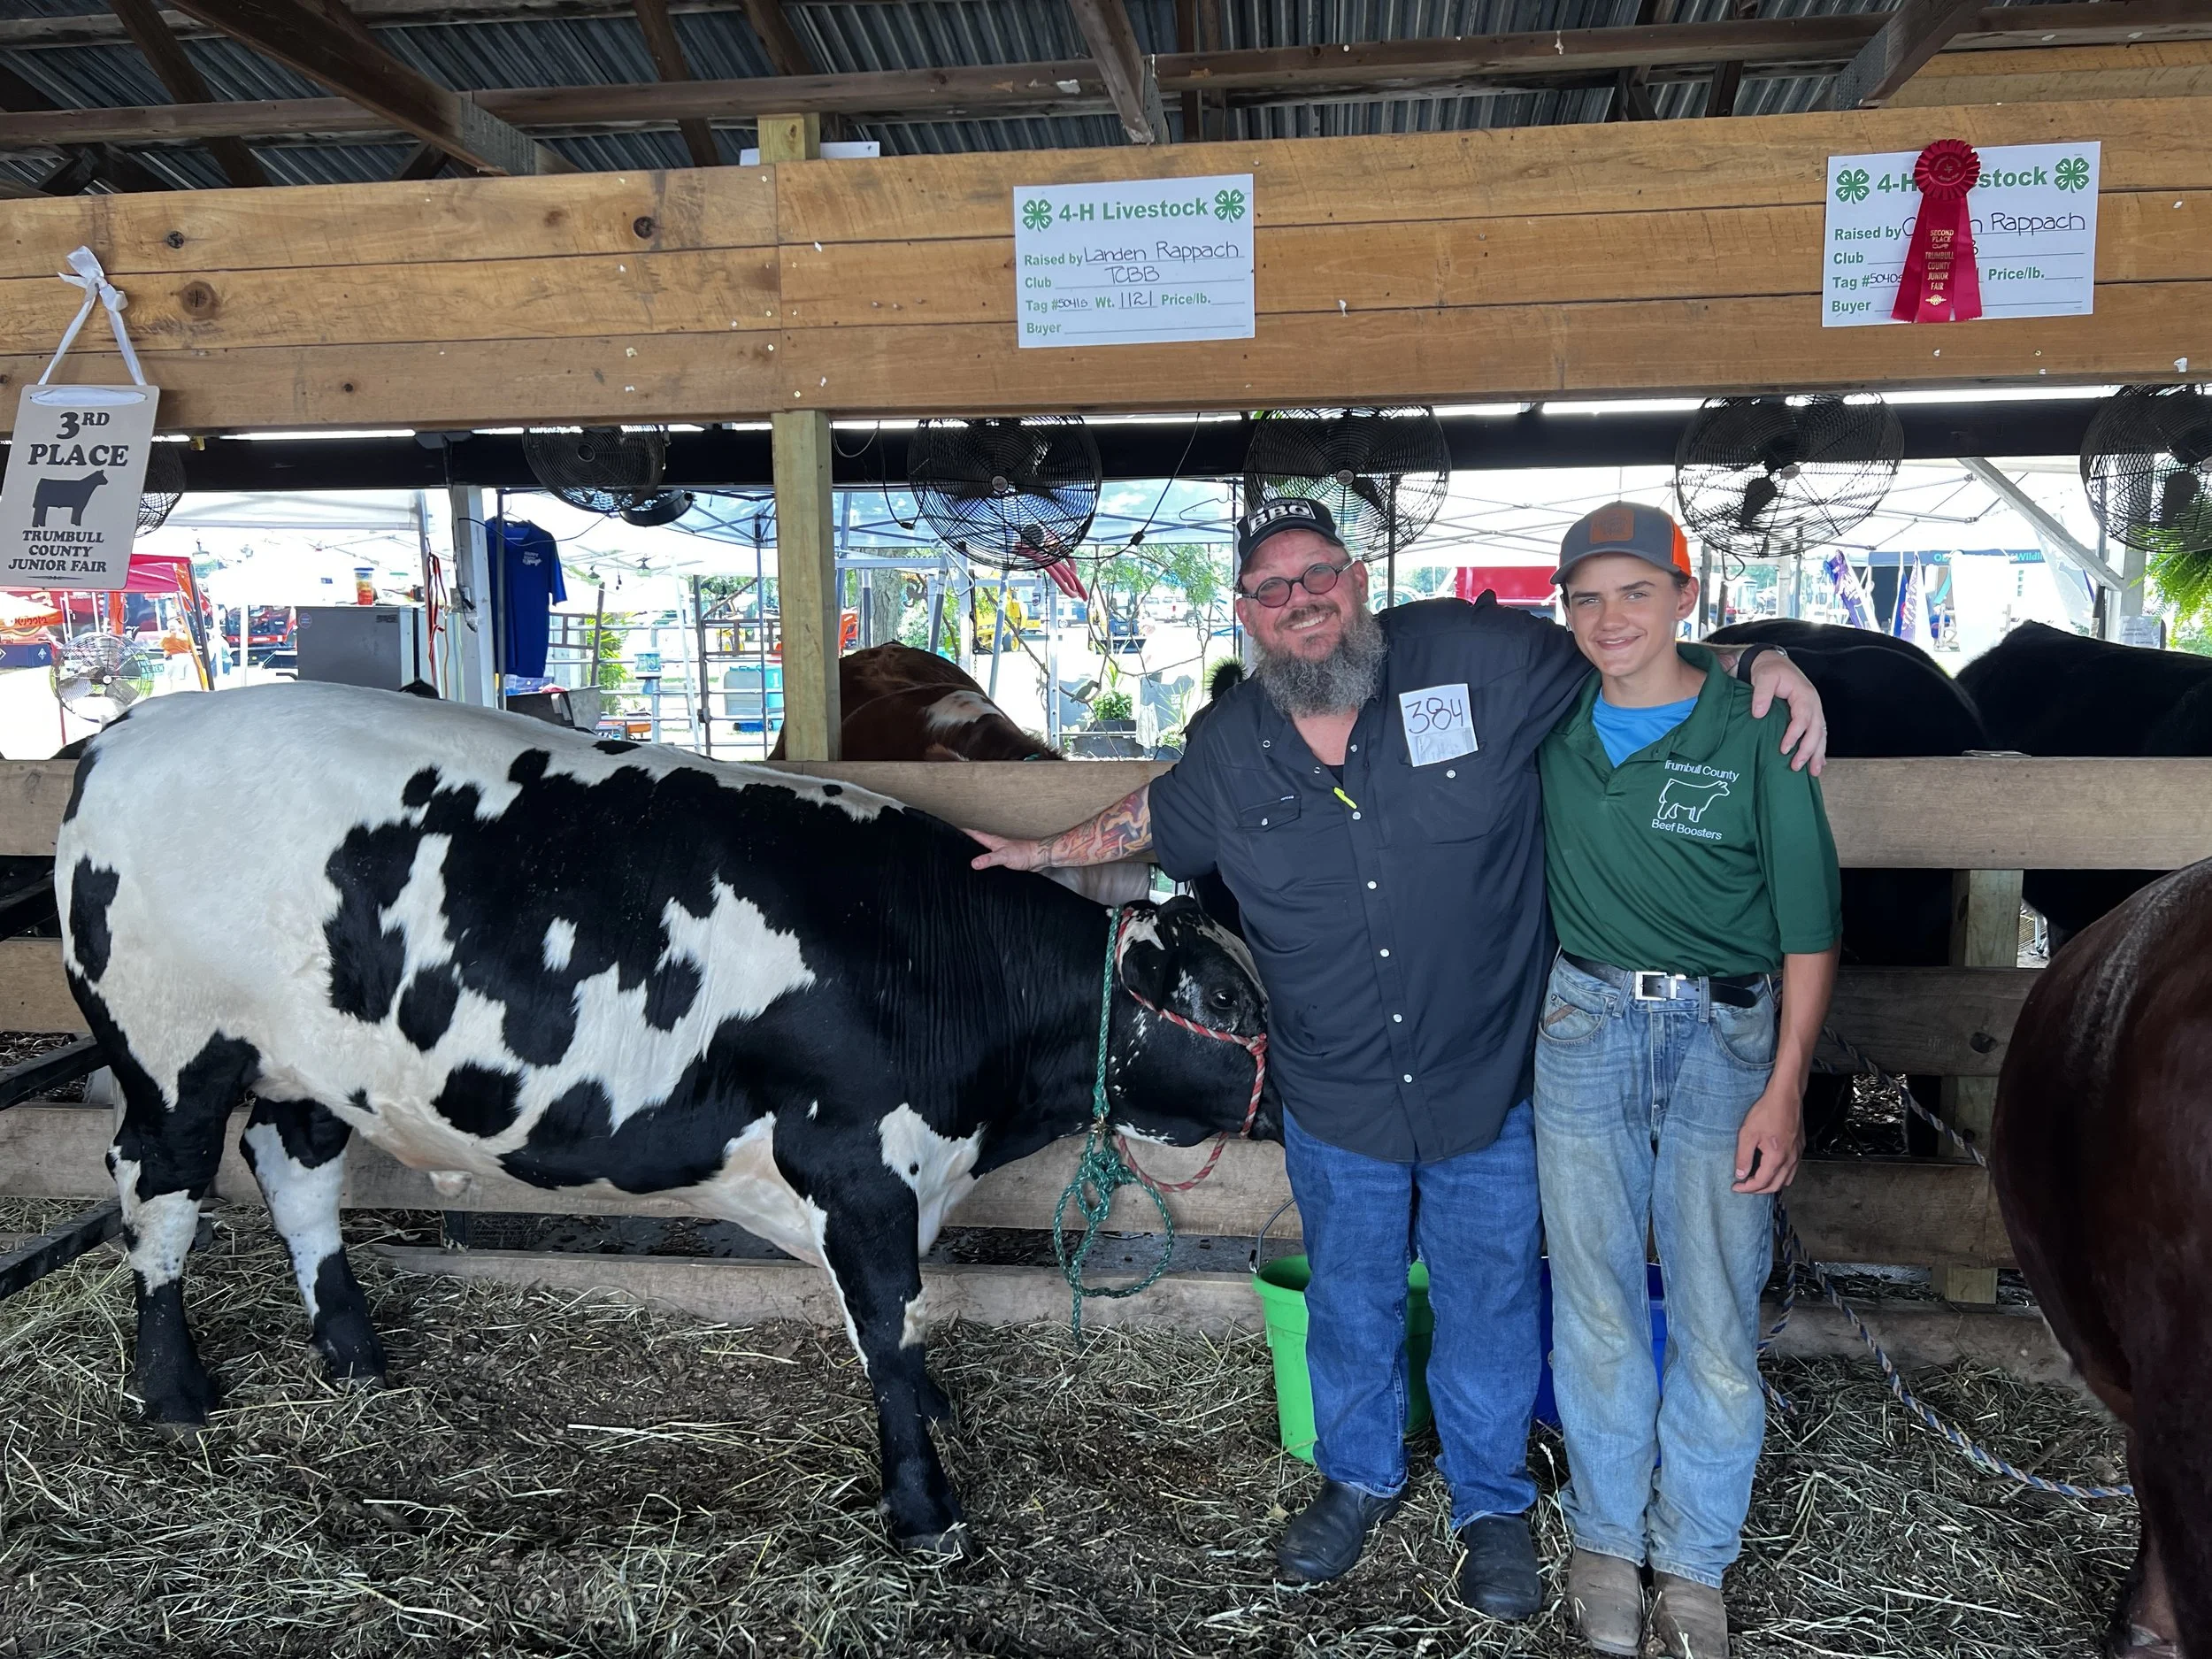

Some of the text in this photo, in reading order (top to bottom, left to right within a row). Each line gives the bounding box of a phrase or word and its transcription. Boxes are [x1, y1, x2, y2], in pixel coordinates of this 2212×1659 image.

[1978, 165, 2047, 188] stock
[1058, 197, 1209, 222] 4-H Livestock
[1834, 227, 1880, 241] Raised
[1885, 226, 1901, 242] by
[1991, 211, 2085, 236] Rappach
[1024, 241, 1240, 266] Raised by Landen Rappach
[1833, 250, 1864, 265] Club
[1025, 265, 1160, 288] Club TCBB
[1832, 276, 1857, 290] Tag
[1988, 266, 2045, 280] Price/lb.
[1025, 300, 1048, 313] Tag
[1095, 296, 1115, 309] Wt.
[1120, 290, 1153, 308] 1121
[1161, 293, 1211, 306] Price/lb.
[1832, 300, 1871, 314] Buyer
[1026, 322, 1061, 335] Buyer
[56, 411, 111, 440] 3RD
[27, 443, 129, 467] PLACE
[1250, 504, 1310, 534] BBQ
[22, 530, 104, 542] TRUMBULL
[28, 545, 94, 557] COUNTY
[8, 558, 107, 572] JUNIOR FAIR
[1405, 697, 1463, 734] 384
[1664, 760, 1740, 783] Trumbull County
[1651, 818, 1723, 841] Beef Boosters
